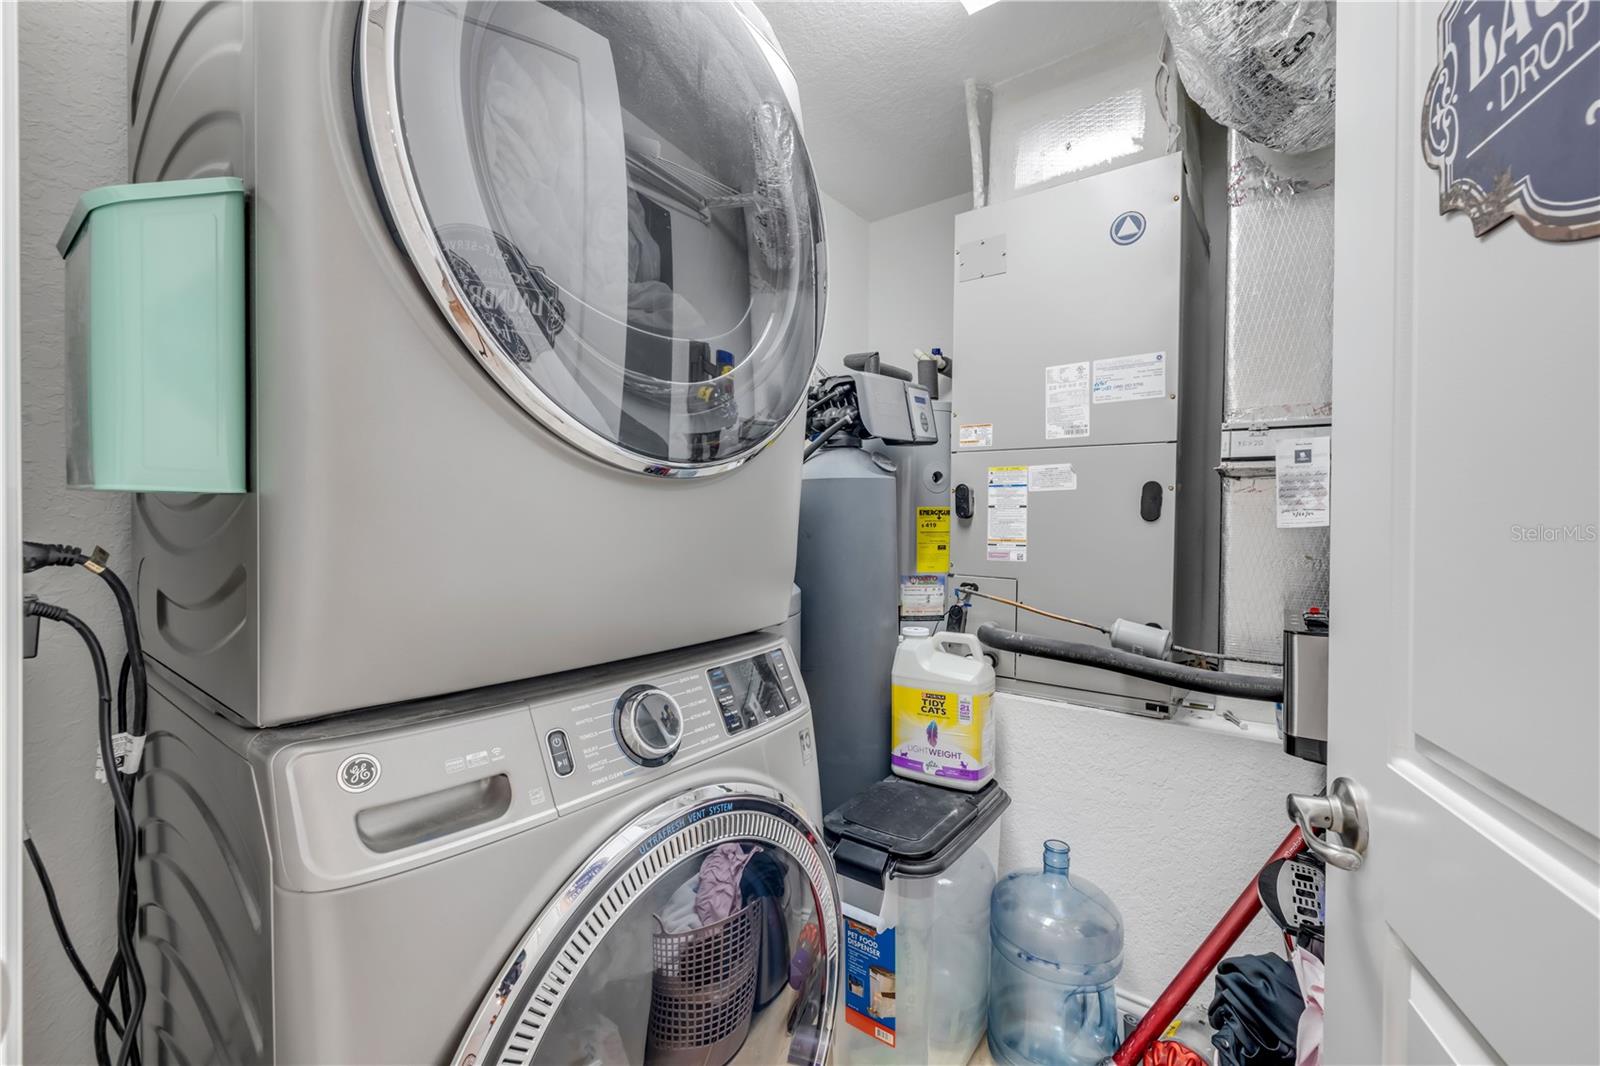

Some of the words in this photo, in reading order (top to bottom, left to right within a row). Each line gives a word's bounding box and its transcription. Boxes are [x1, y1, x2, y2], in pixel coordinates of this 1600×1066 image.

[921, 698, 945, 708] TIDY
[921, 706, 947, 716] CATS
[907, 744, 962, 760] LIGHTWEIGHT
[639, 818, 686, 855] ULTRAFRESH
[687, 810, 705, 823] VENT
[708, 803, 733, 815] SYSTEM
[847, 930, 858, 941] PET
[859, 935, 879, 949] FOOD
[847, 937, 881, 958] DISPENSER
